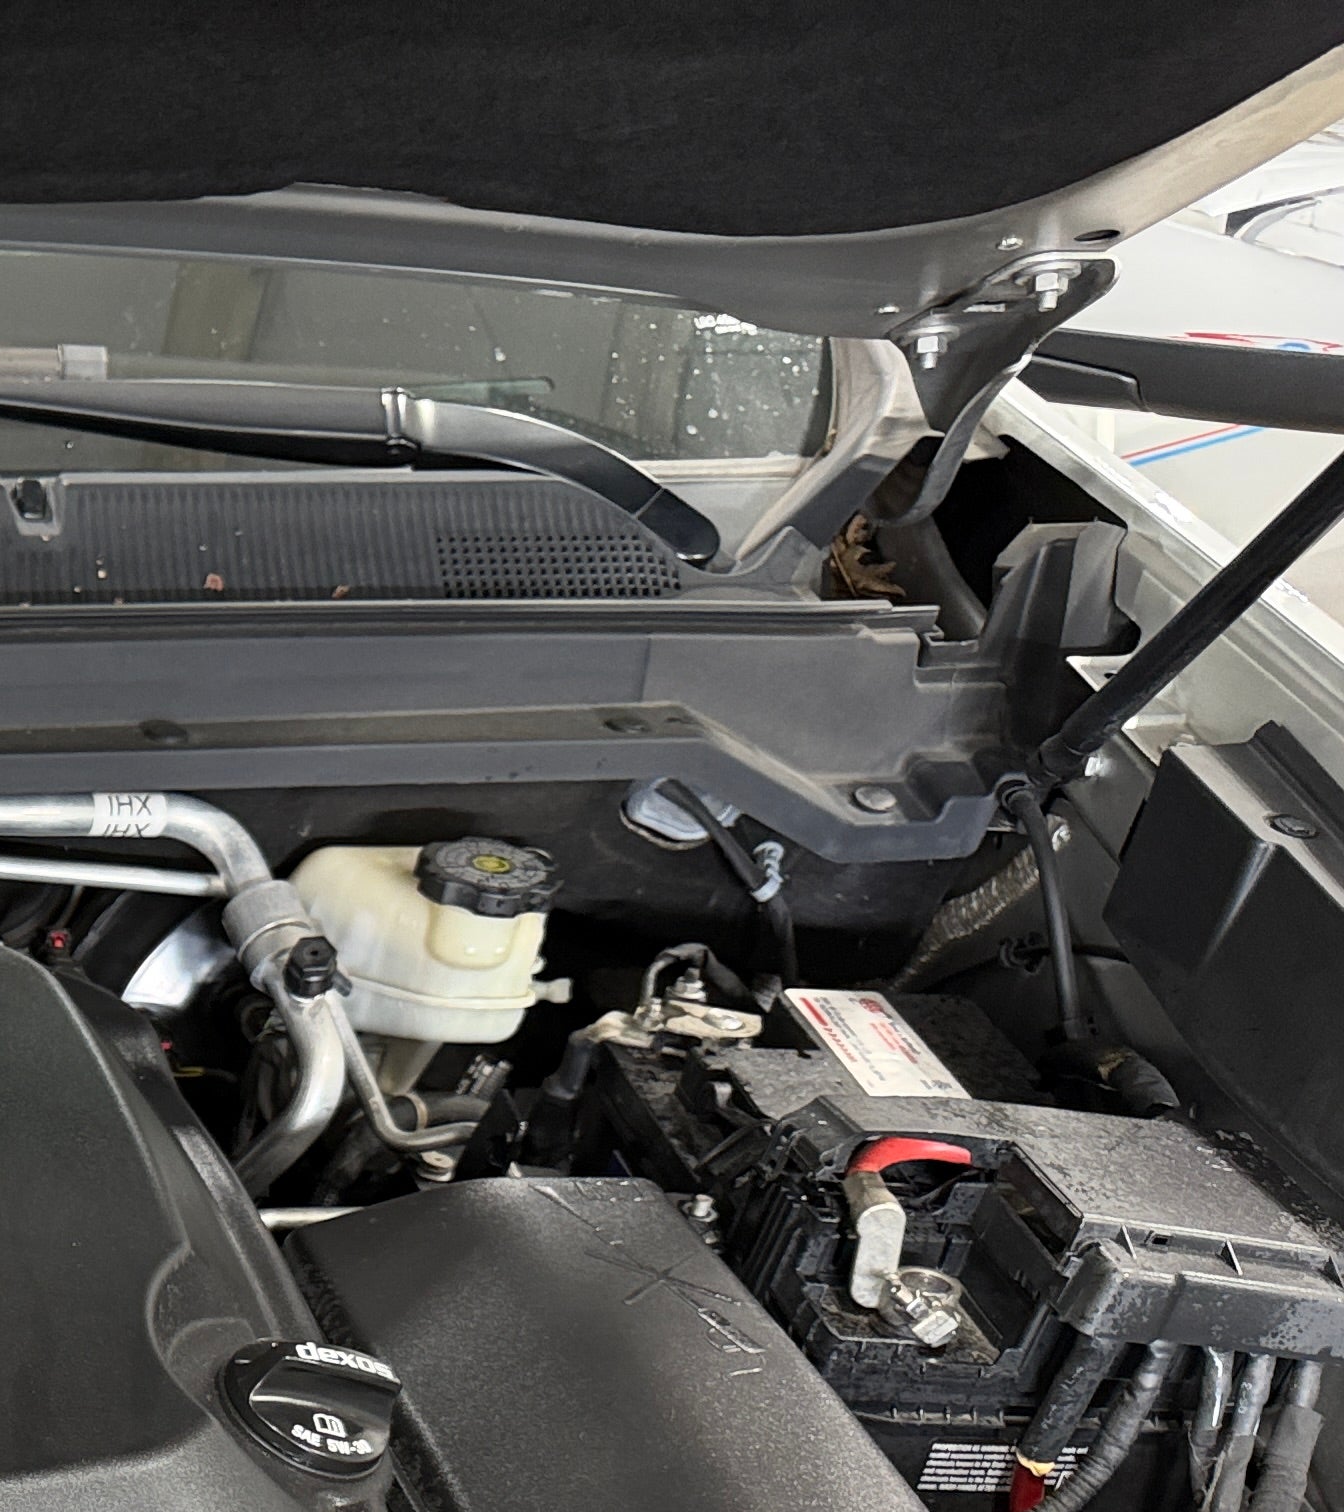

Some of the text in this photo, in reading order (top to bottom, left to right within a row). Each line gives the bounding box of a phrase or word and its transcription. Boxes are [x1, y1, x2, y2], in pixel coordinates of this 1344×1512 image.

[107, 795, 152, 816] IHX
[295, 1341, 395, 1380] dexos
[291, 1424, 322, 1447] SAE
